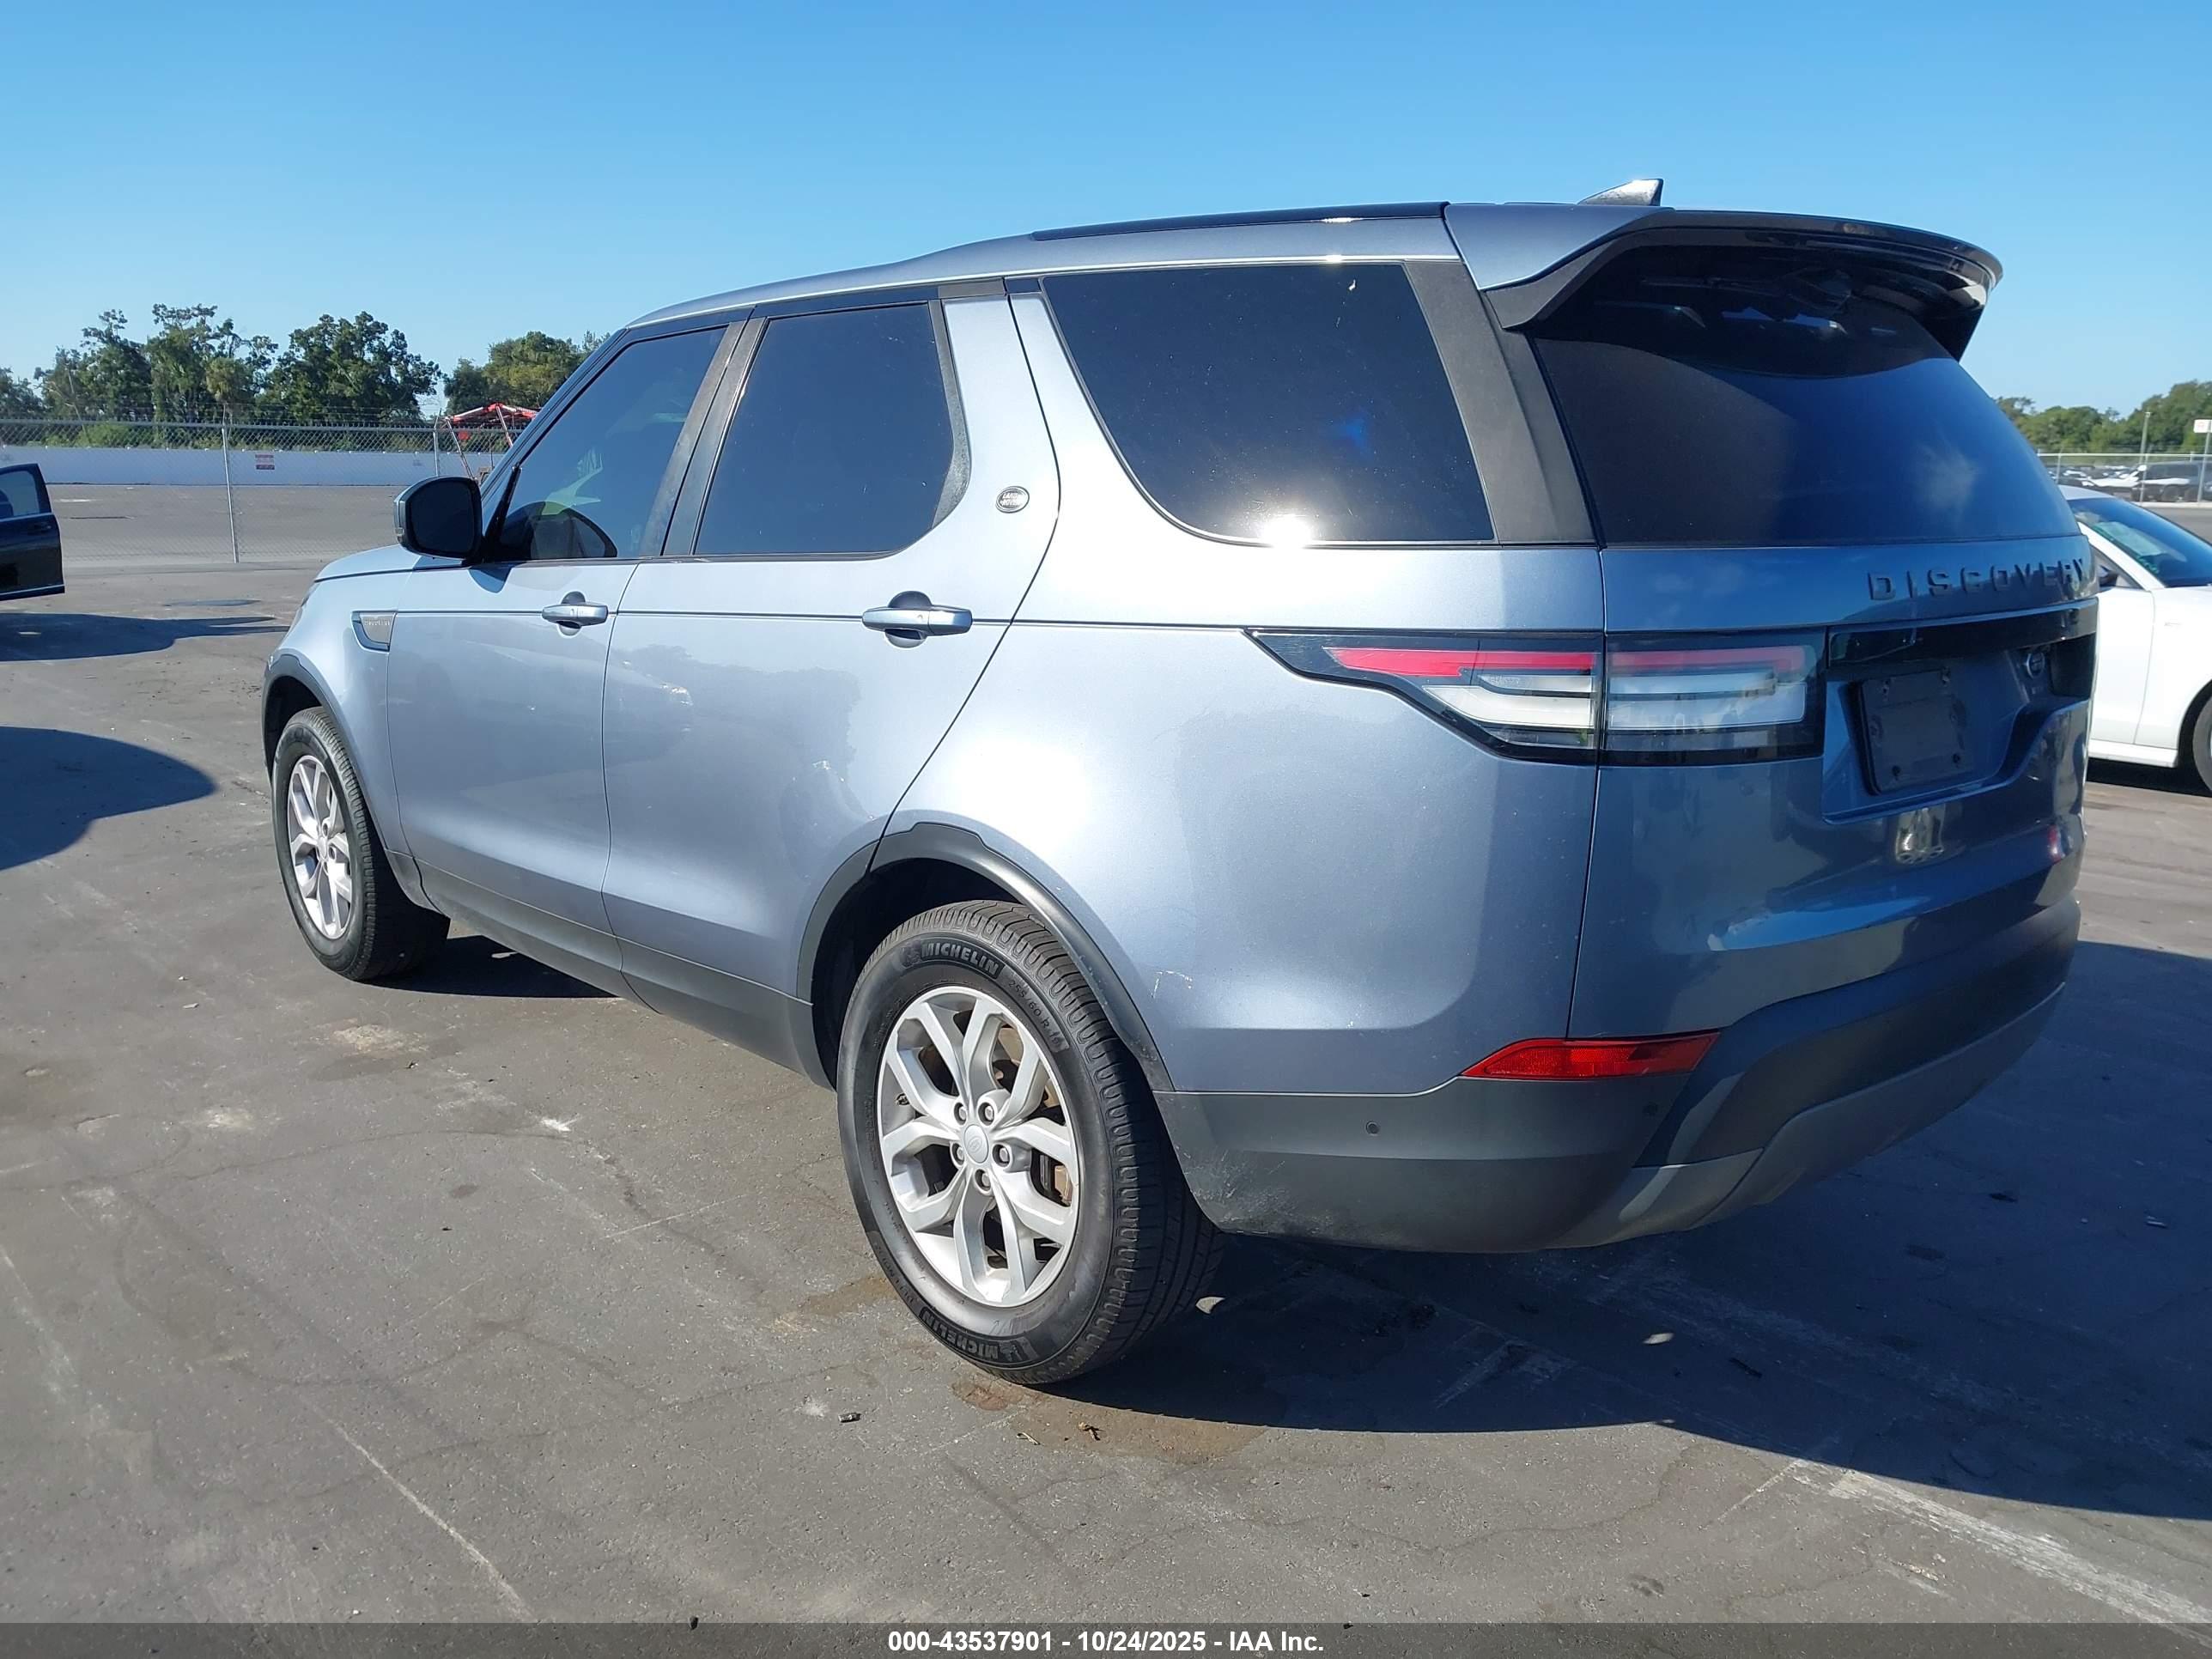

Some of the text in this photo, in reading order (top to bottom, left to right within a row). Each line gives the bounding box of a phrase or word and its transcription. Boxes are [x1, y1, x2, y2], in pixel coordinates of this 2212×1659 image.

[1867, 558, 2084, 600] DISCOVERY
[921, 942, 1000, 975] MICHELIN
[921, 1310, 999, 1359] MICHELIN
